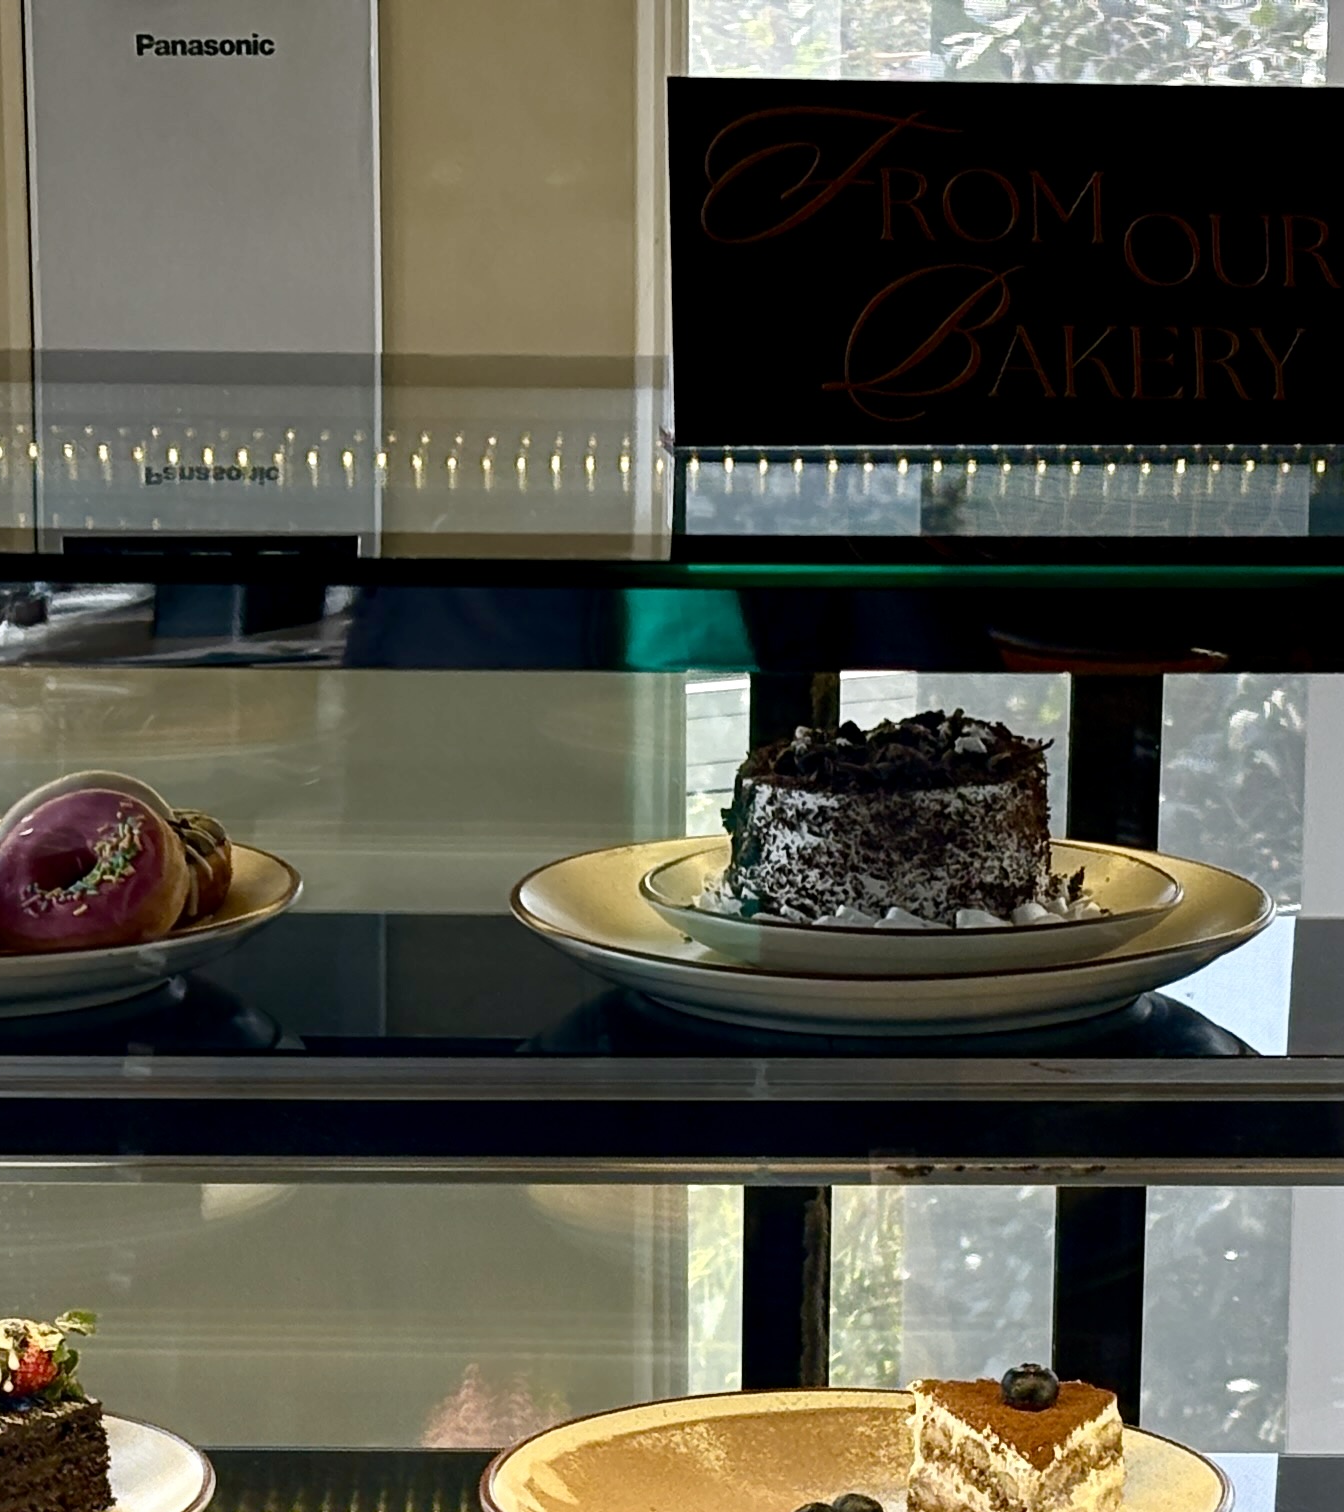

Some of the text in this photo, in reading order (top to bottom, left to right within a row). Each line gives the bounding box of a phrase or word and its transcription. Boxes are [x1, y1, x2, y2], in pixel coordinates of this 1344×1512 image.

[135, 33, 275, 56] Panasonic
[1123, 212, 1342, 288] OUR
[821, 263, 1306, 422] BAKERY
